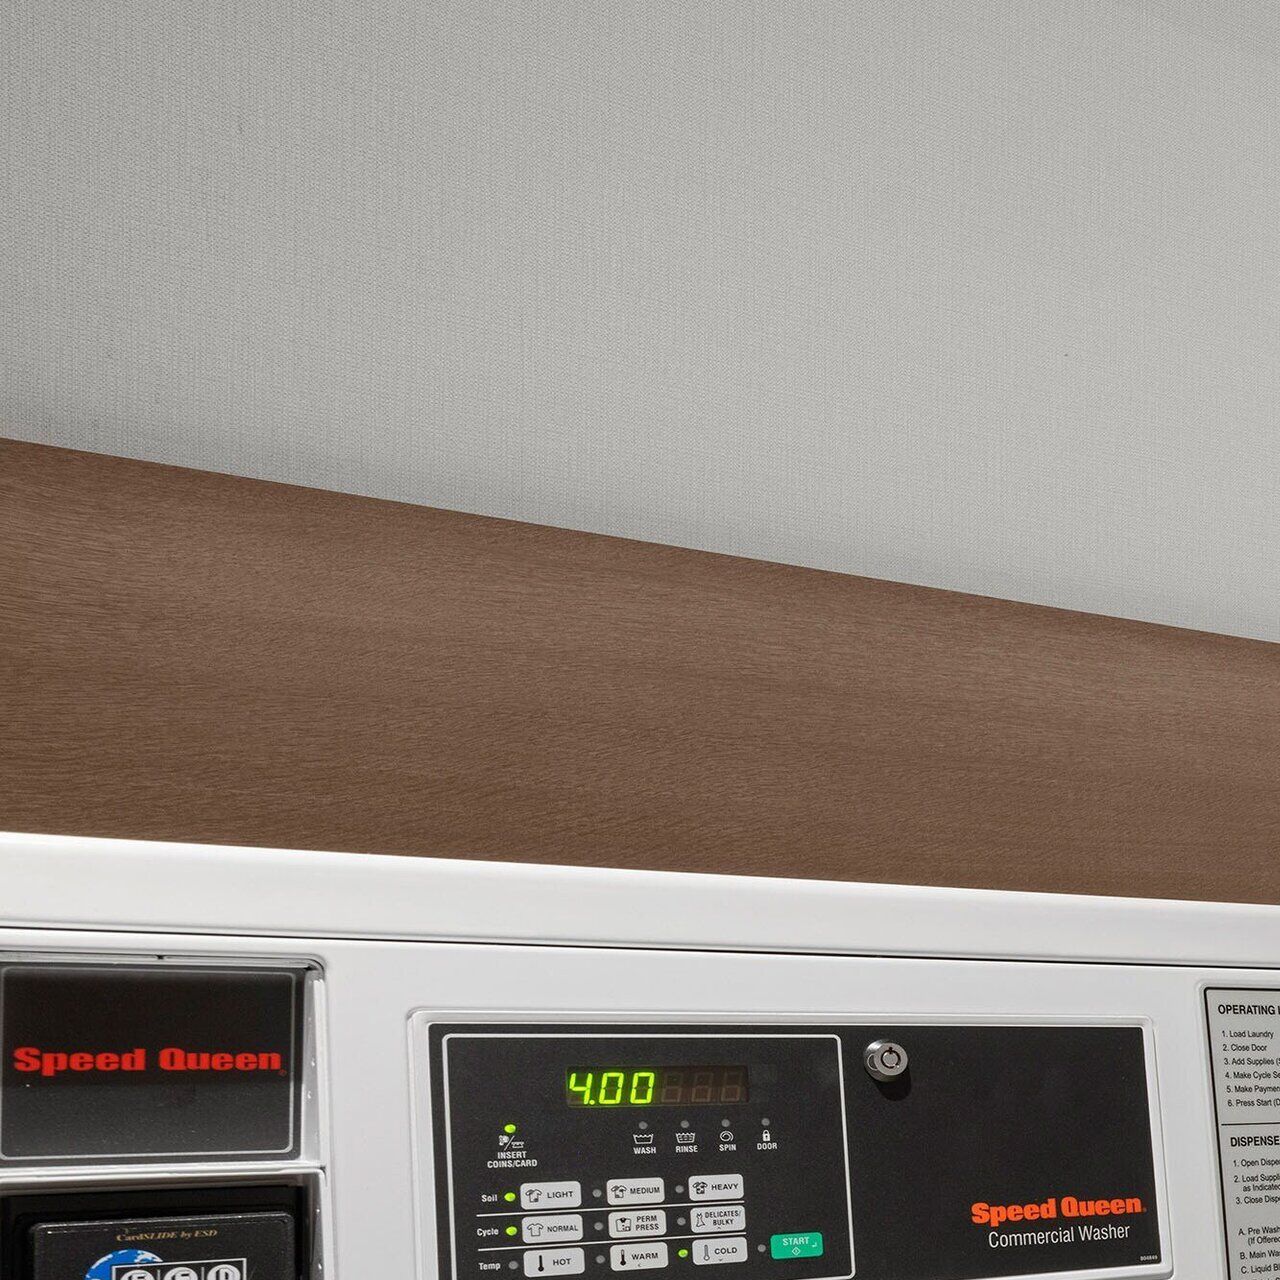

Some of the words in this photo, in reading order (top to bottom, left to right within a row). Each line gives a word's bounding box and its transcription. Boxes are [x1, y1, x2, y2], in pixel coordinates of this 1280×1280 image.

[1218, 1004, 1276, 1015] OPERATING
[1248, 1031, 1274, 1039] Laundry
[13, 1047, 145, 1076] Speed
[159, 1048, 281, 1070] Queen
[1247, 1058, 1274, 1067] Supplies
[1253, 1072, 1271, 1080] Cycle
[569, 1072, 655, 1105] 4.00
[1228, 1099, 1234, 1107] 6.
[1236, 1099, 1255, 1107] Press
[497, 1151, 527, 1159] INSERT
[487, 1159, 538, 1168] COINS/CARD
[1241, 1159, 1259, 1168] Open
[482, 1194, 498, 1202] Soil
[547, 1191, 573, 1199] LIGHT
[1244, 1196, 1263, 1204] Close
[970, 1198, 1056, 1227] Speed
[1061, 1196, 1143, 1217] Queen
[477, 1228, 499, 1237] Cycle
[1248, 1227, 1260, 1235] Pre
[1262, 1226, 1280, 1234] Wash
[116, 1231, 177, 1242] CardSLIDE
[181, 1231, 191, 1239] by
[194, 1230, 218, 1238] ESD
[988, 1226, 1074, 1248] Commercial
[1079, 1224, 1130, 1241] Washer
[782, 1237, 809, 1245] START
[1249, 1251, 1266, 1259] Main
[479, 1262, 500, 1271] Temp
[1241, 1266, 1249, 1274] C.
[1251, 1265, 1272, 1273] Liquid
